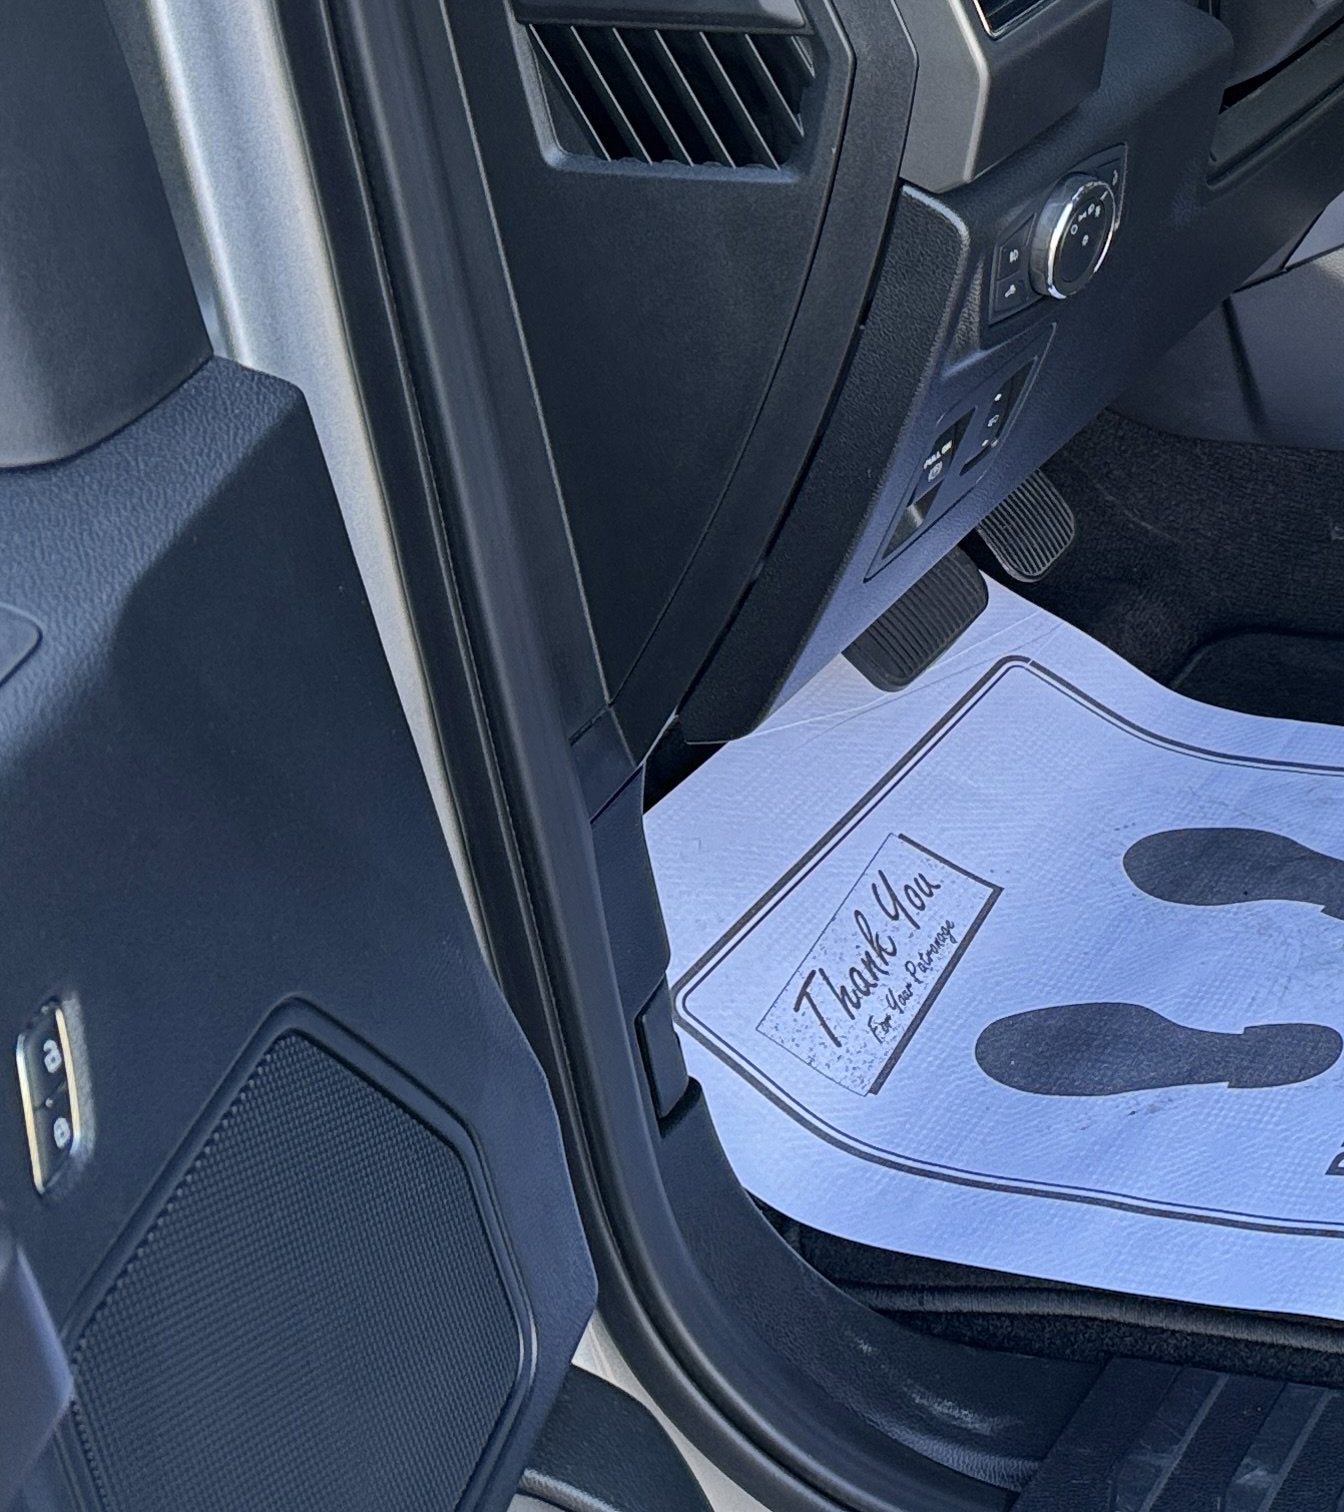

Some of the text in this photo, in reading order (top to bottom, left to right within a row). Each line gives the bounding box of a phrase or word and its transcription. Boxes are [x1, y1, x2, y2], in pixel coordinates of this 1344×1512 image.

[793, 870, 942, 1048] Thank You
[868, 920, 958, 1044] For Your Patronage
